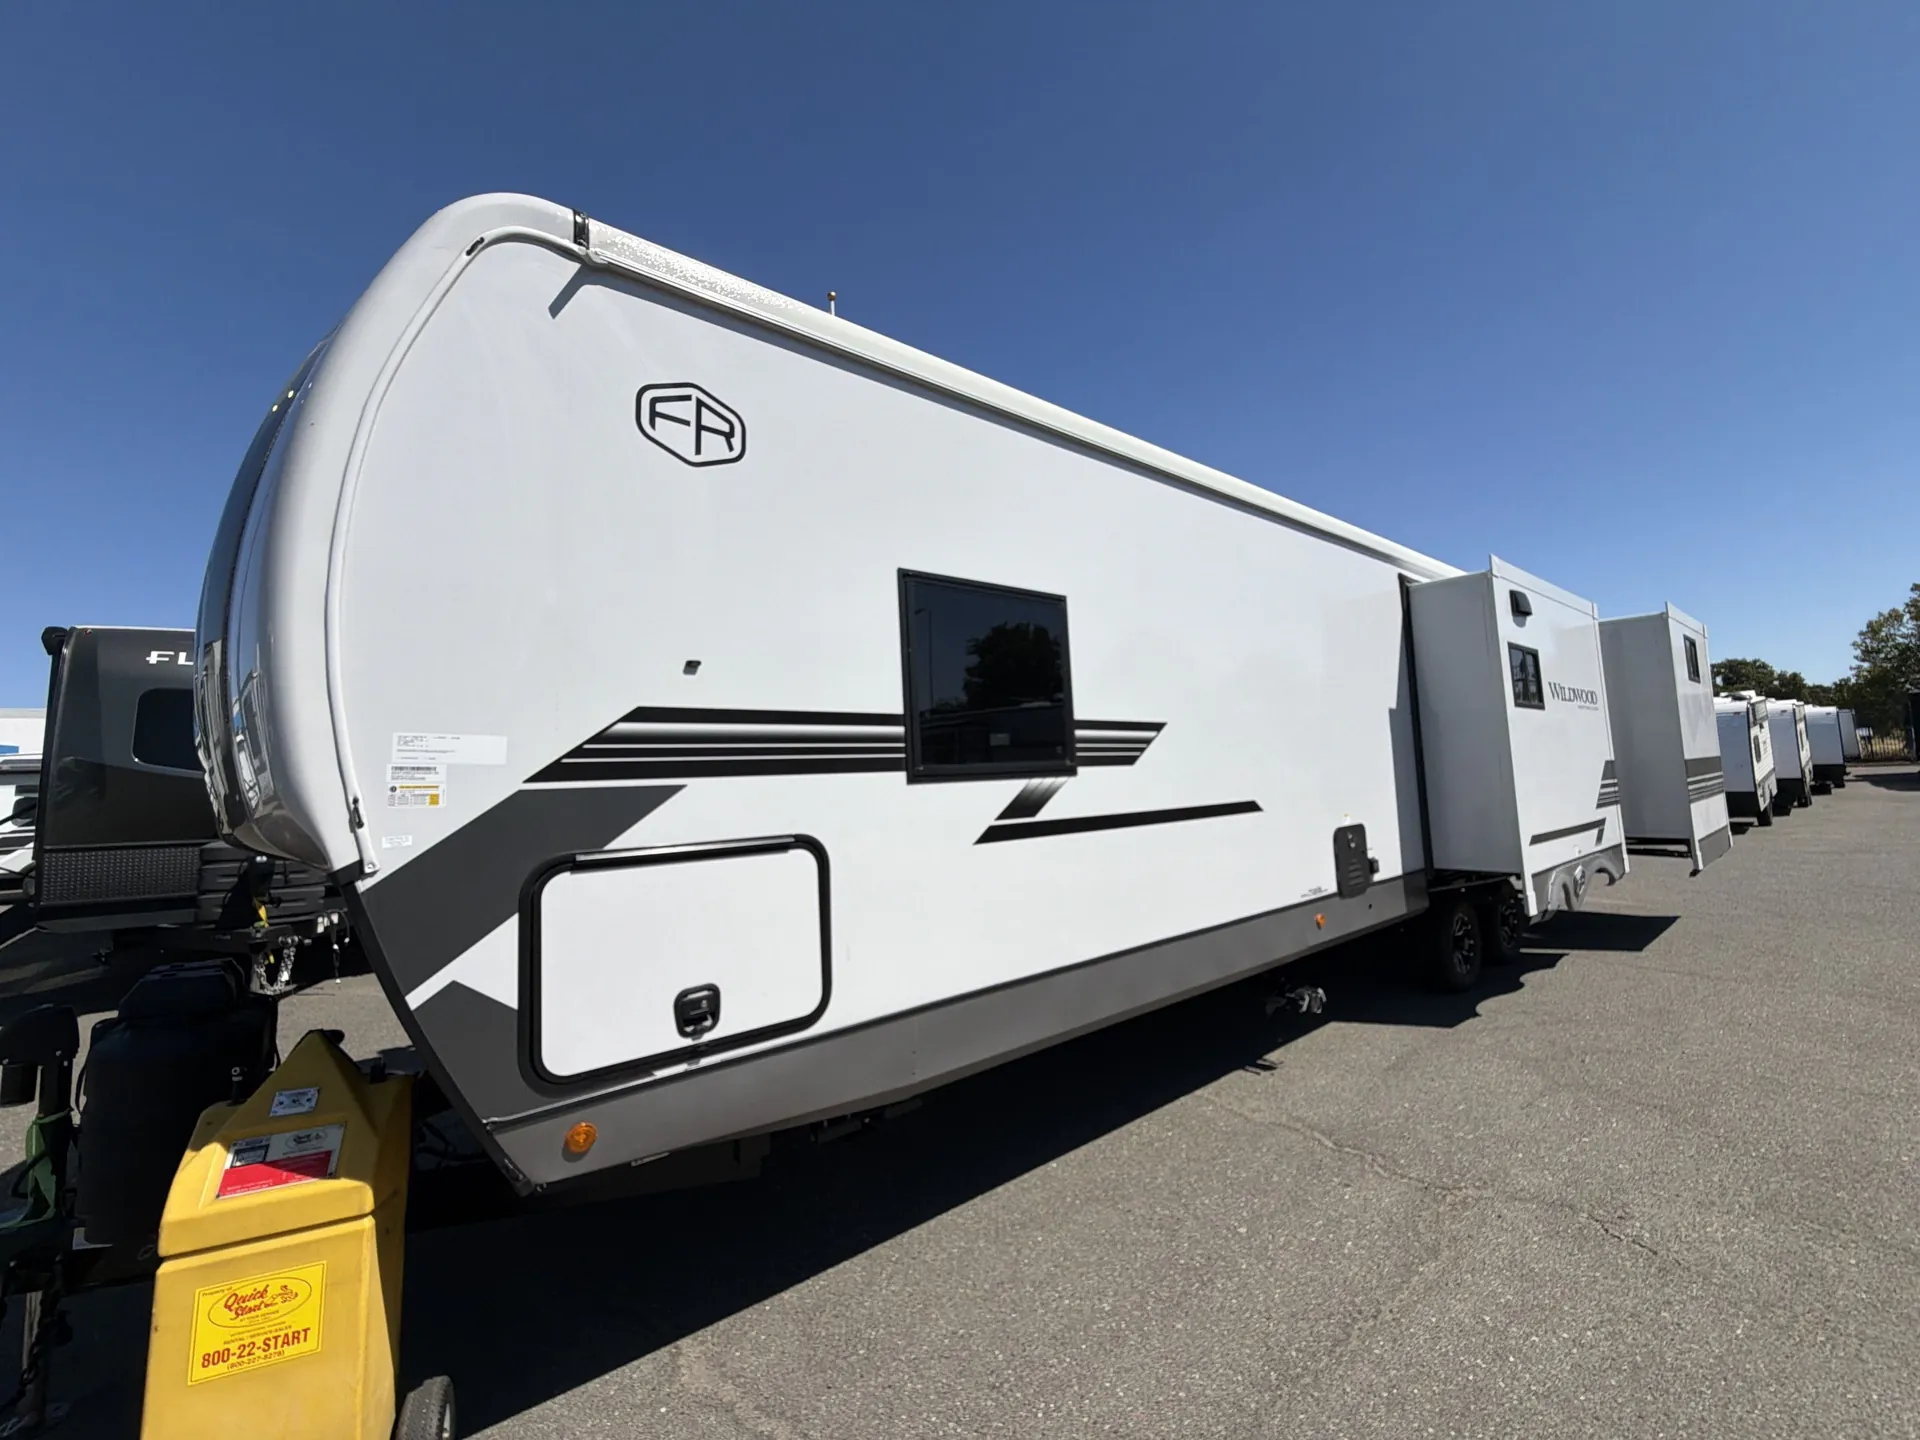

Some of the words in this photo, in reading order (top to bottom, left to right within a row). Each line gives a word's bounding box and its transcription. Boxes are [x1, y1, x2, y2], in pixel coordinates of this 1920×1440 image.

[649, 394, 735, 456] FR
[1548, 681, 1598, 705] WILDWOOD
[223, 1284, 270, 1312] Quick
[229, 1300, 267, 1321] Start
[201, 1327, 311, 1368] 800-22-START
